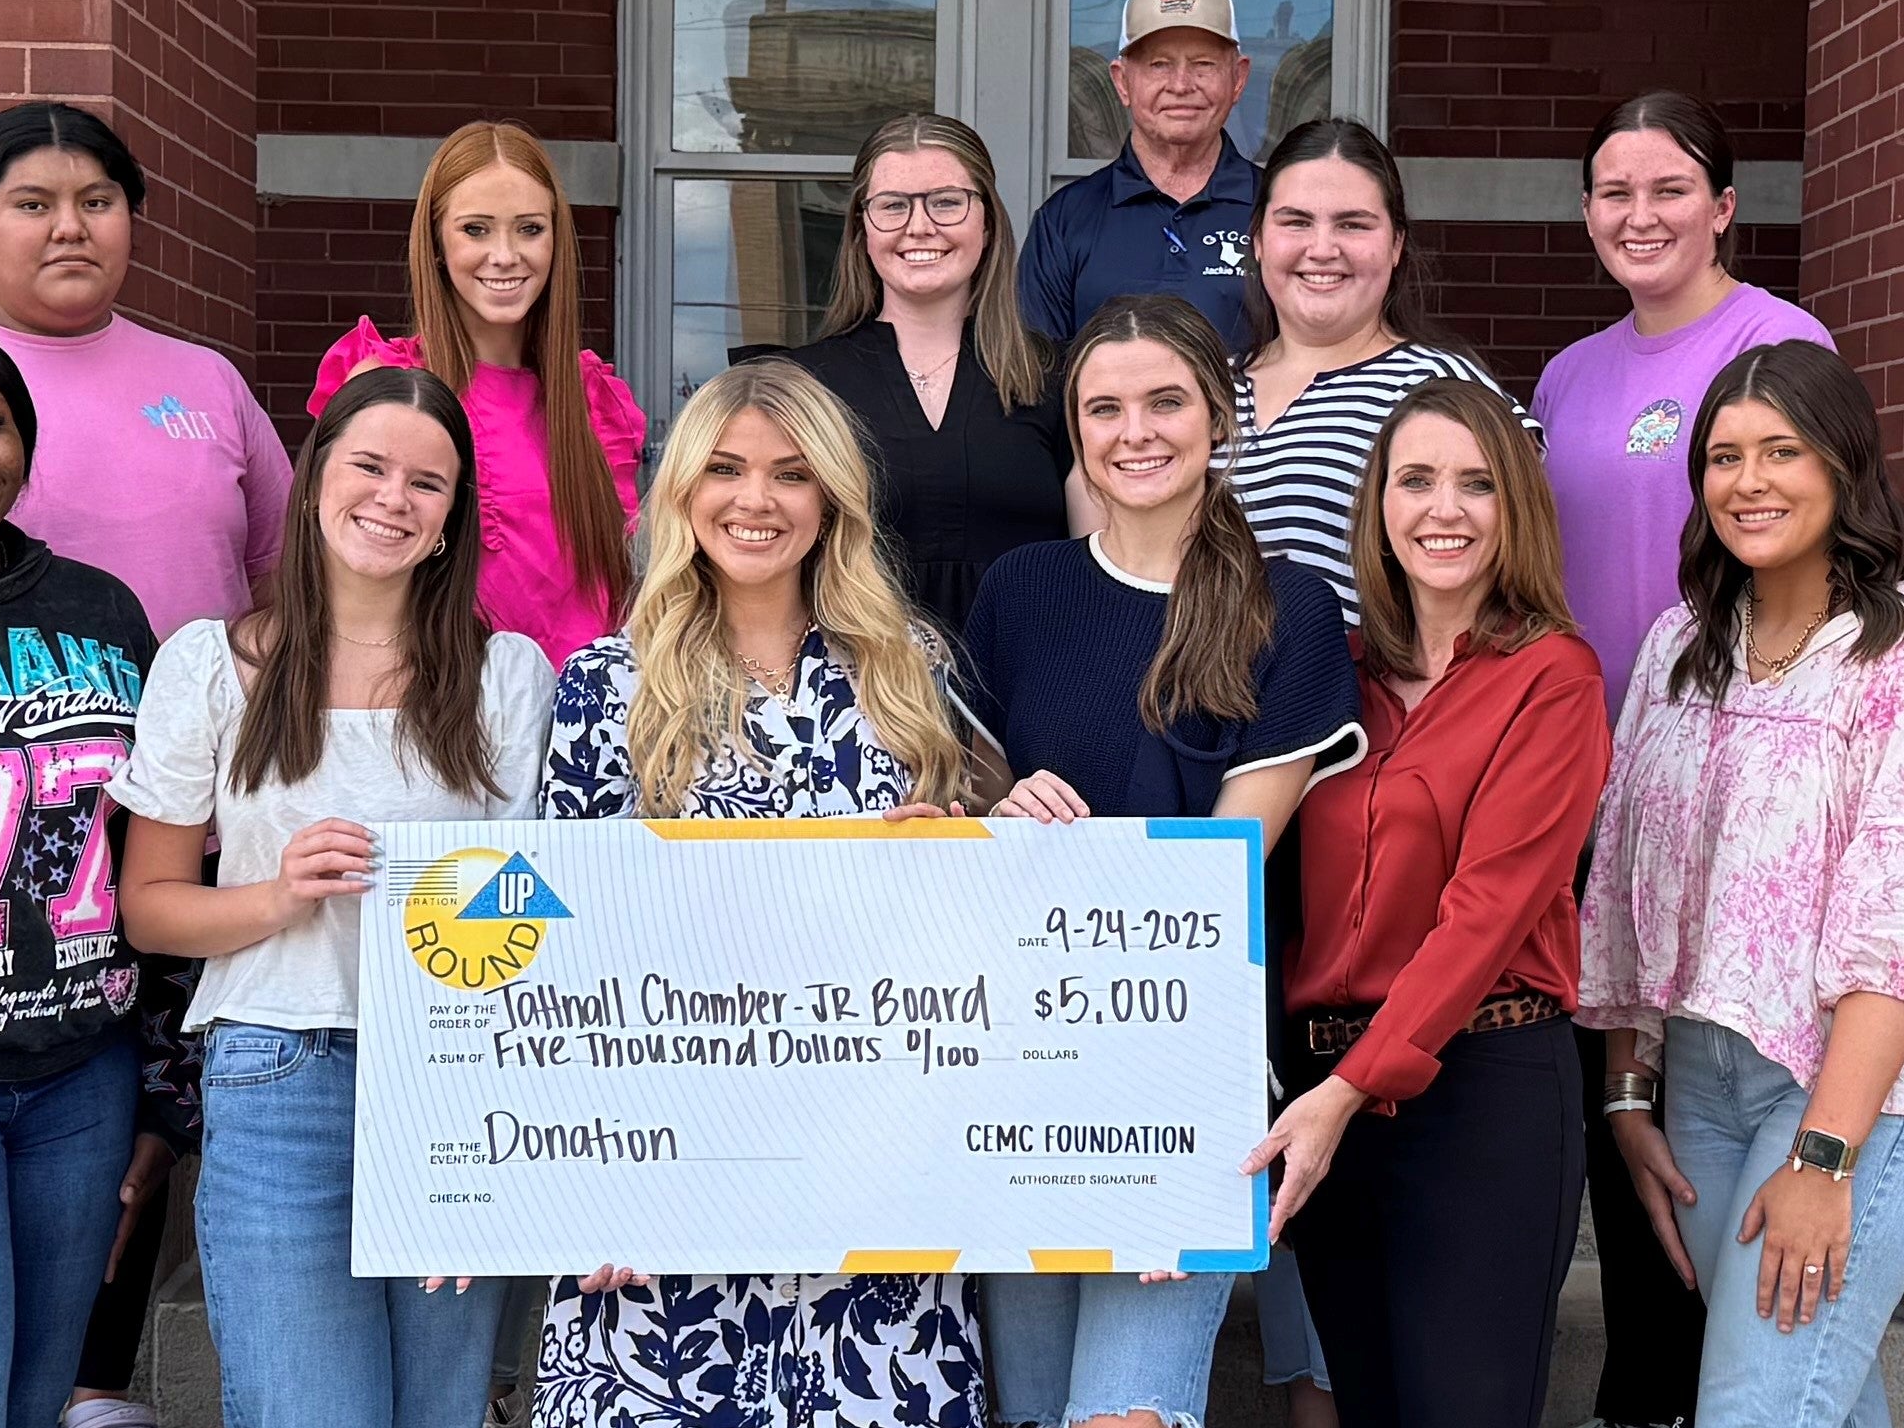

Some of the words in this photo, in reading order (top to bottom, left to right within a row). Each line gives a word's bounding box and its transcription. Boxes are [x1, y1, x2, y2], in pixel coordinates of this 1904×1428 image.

[498, 872, 535, 915] UP
[387, 898, 458, 906] OPERATION
[1046, 907, 1221, 952] 9-24-2025
[1018, 938, 1048, 947] DATE
[406, 921, 540, 988] ROUND
[872, 974, 991, 1031] Board
[429, 1005, 451, 1015] PAY
[454, 1005, 470, 1015] OF
[474, 1004, 496, 1015] THE
[429, 1018, 472, 1029] ORDER
[474, 1018, 490, 1028] OF
[493, 1029, 571, 1069] Five
[576, 1027, 757, 1068] Thousand
[768, 1028, 882, 1068] Dollars
[428, 1054, 438, 1063] A
[439, 1054, 465, 1063] SUM
[469, 1053, 485, 1063] OF
[1022, 1049, 1079, 1060] DOLLARS
[484, 1111, 678, 1165] Donation
[966, 1124, 1034, 1153] CEMC
[1045, 1125, 1195, 1154] FOUNDATION
[430, 1143, 454, 1153] FOR
[459, 1142, 481, 1152] THE
[430, 1155, 468, 1165] EVENT
[472, 1154, 487, 1165] OF
[1009, 1174, 1086, 1185] AUTHORIZED
[1089, 1174, 1157, 1185] SIGNATURE
[429, 1193, 471, 1204] CHECK
